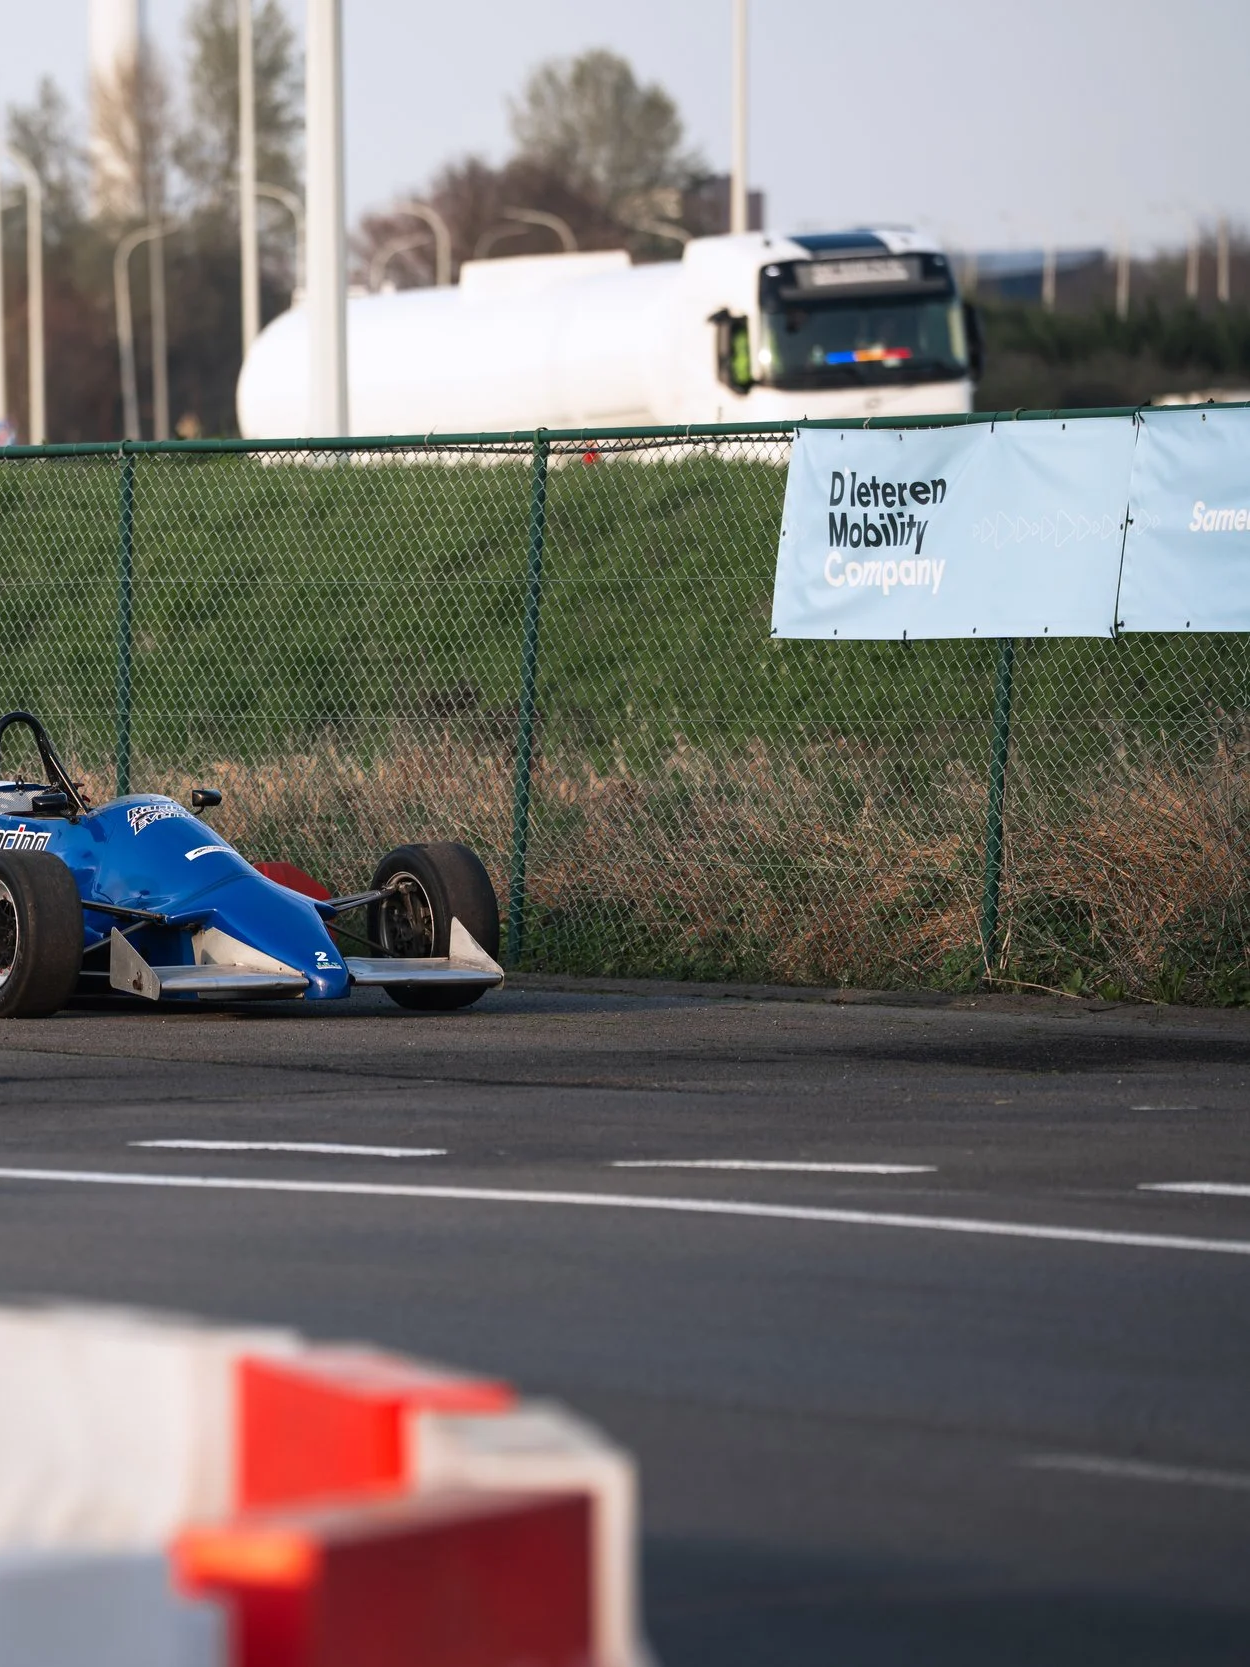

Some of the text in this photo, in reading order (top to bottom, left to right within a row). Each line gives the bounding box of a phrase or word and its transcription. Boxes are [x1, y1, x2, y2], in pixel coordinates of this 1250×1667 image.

[828, 511, 929, 554] Mobility
[1189, 501, 1250, 531] Same
[823, 550, 946, 596] Company
[314, 951, 329, 961] 2
